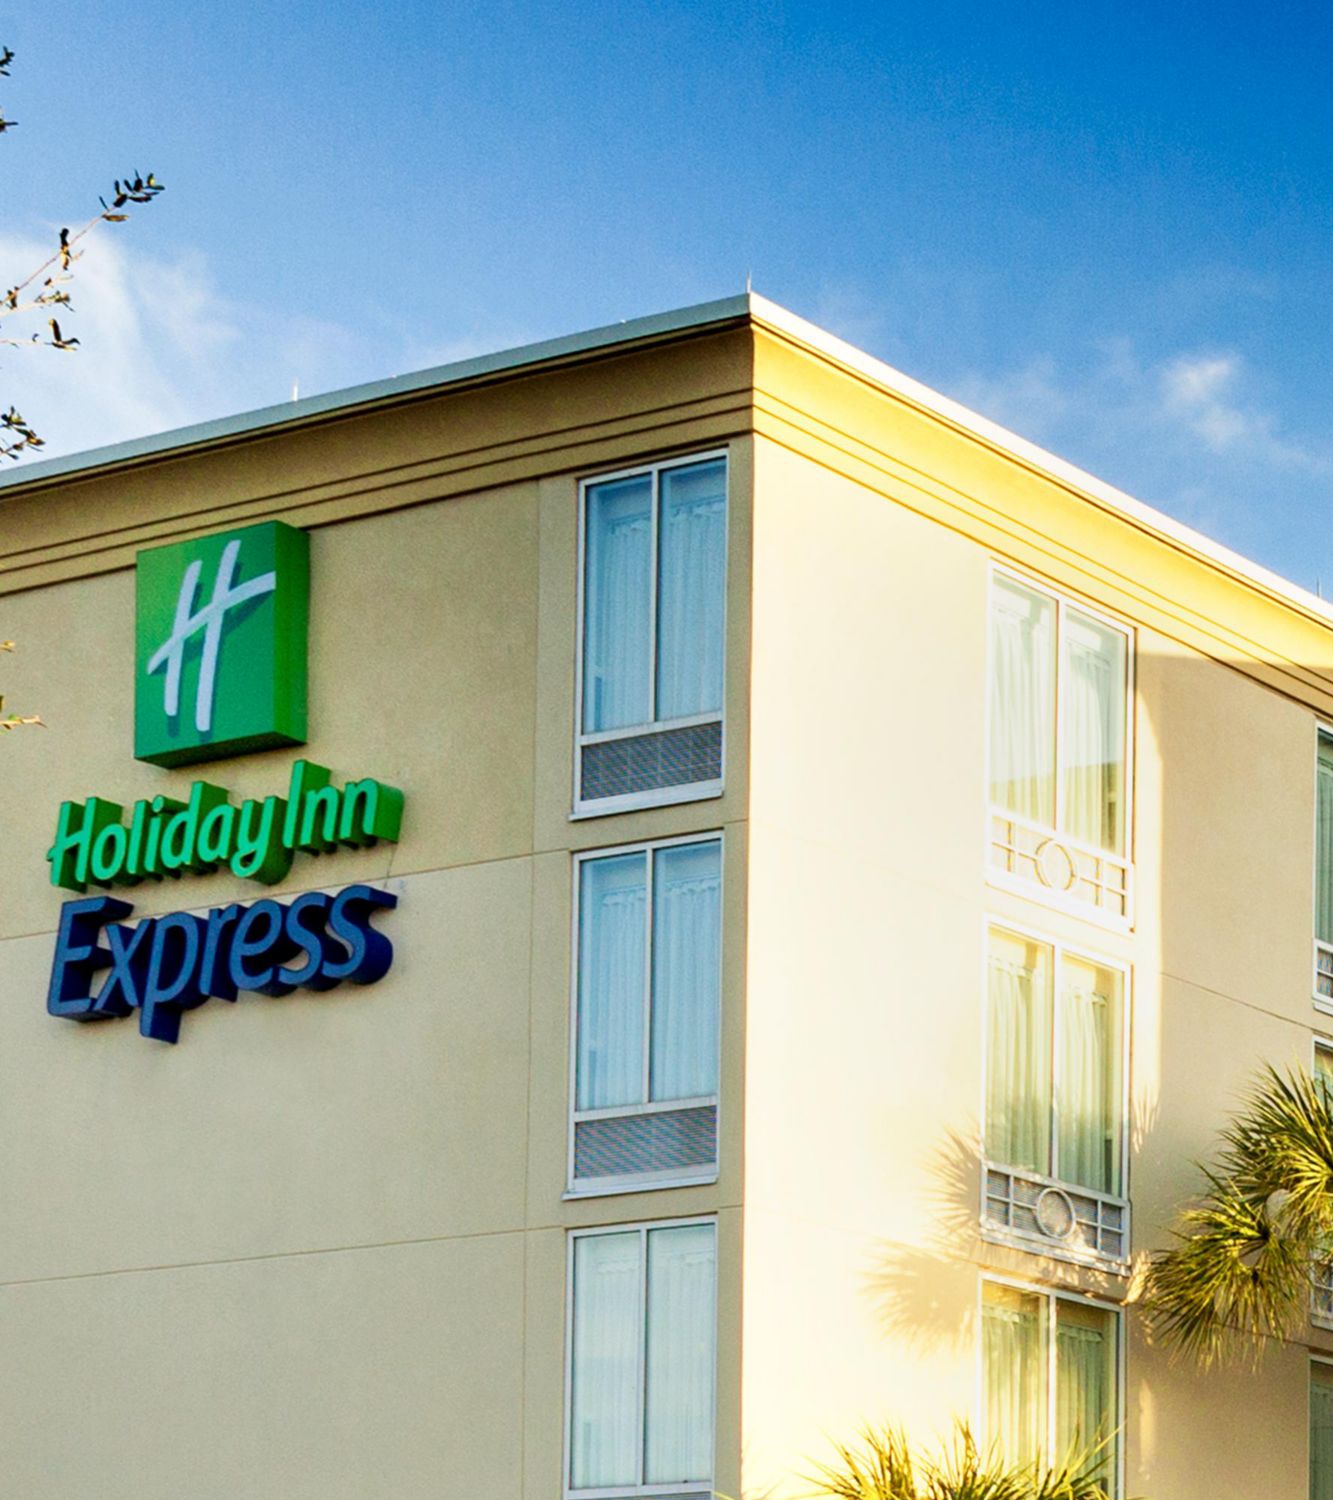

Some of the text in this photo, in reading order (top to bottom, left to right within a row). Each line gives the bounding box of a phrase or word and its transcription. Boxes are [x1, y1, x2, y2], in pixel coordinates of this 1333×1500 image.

[148, 540, 276, 731] H
[48, 760, 396, 890] Holiday Inn
[47, 884, 397, 1043] Express
